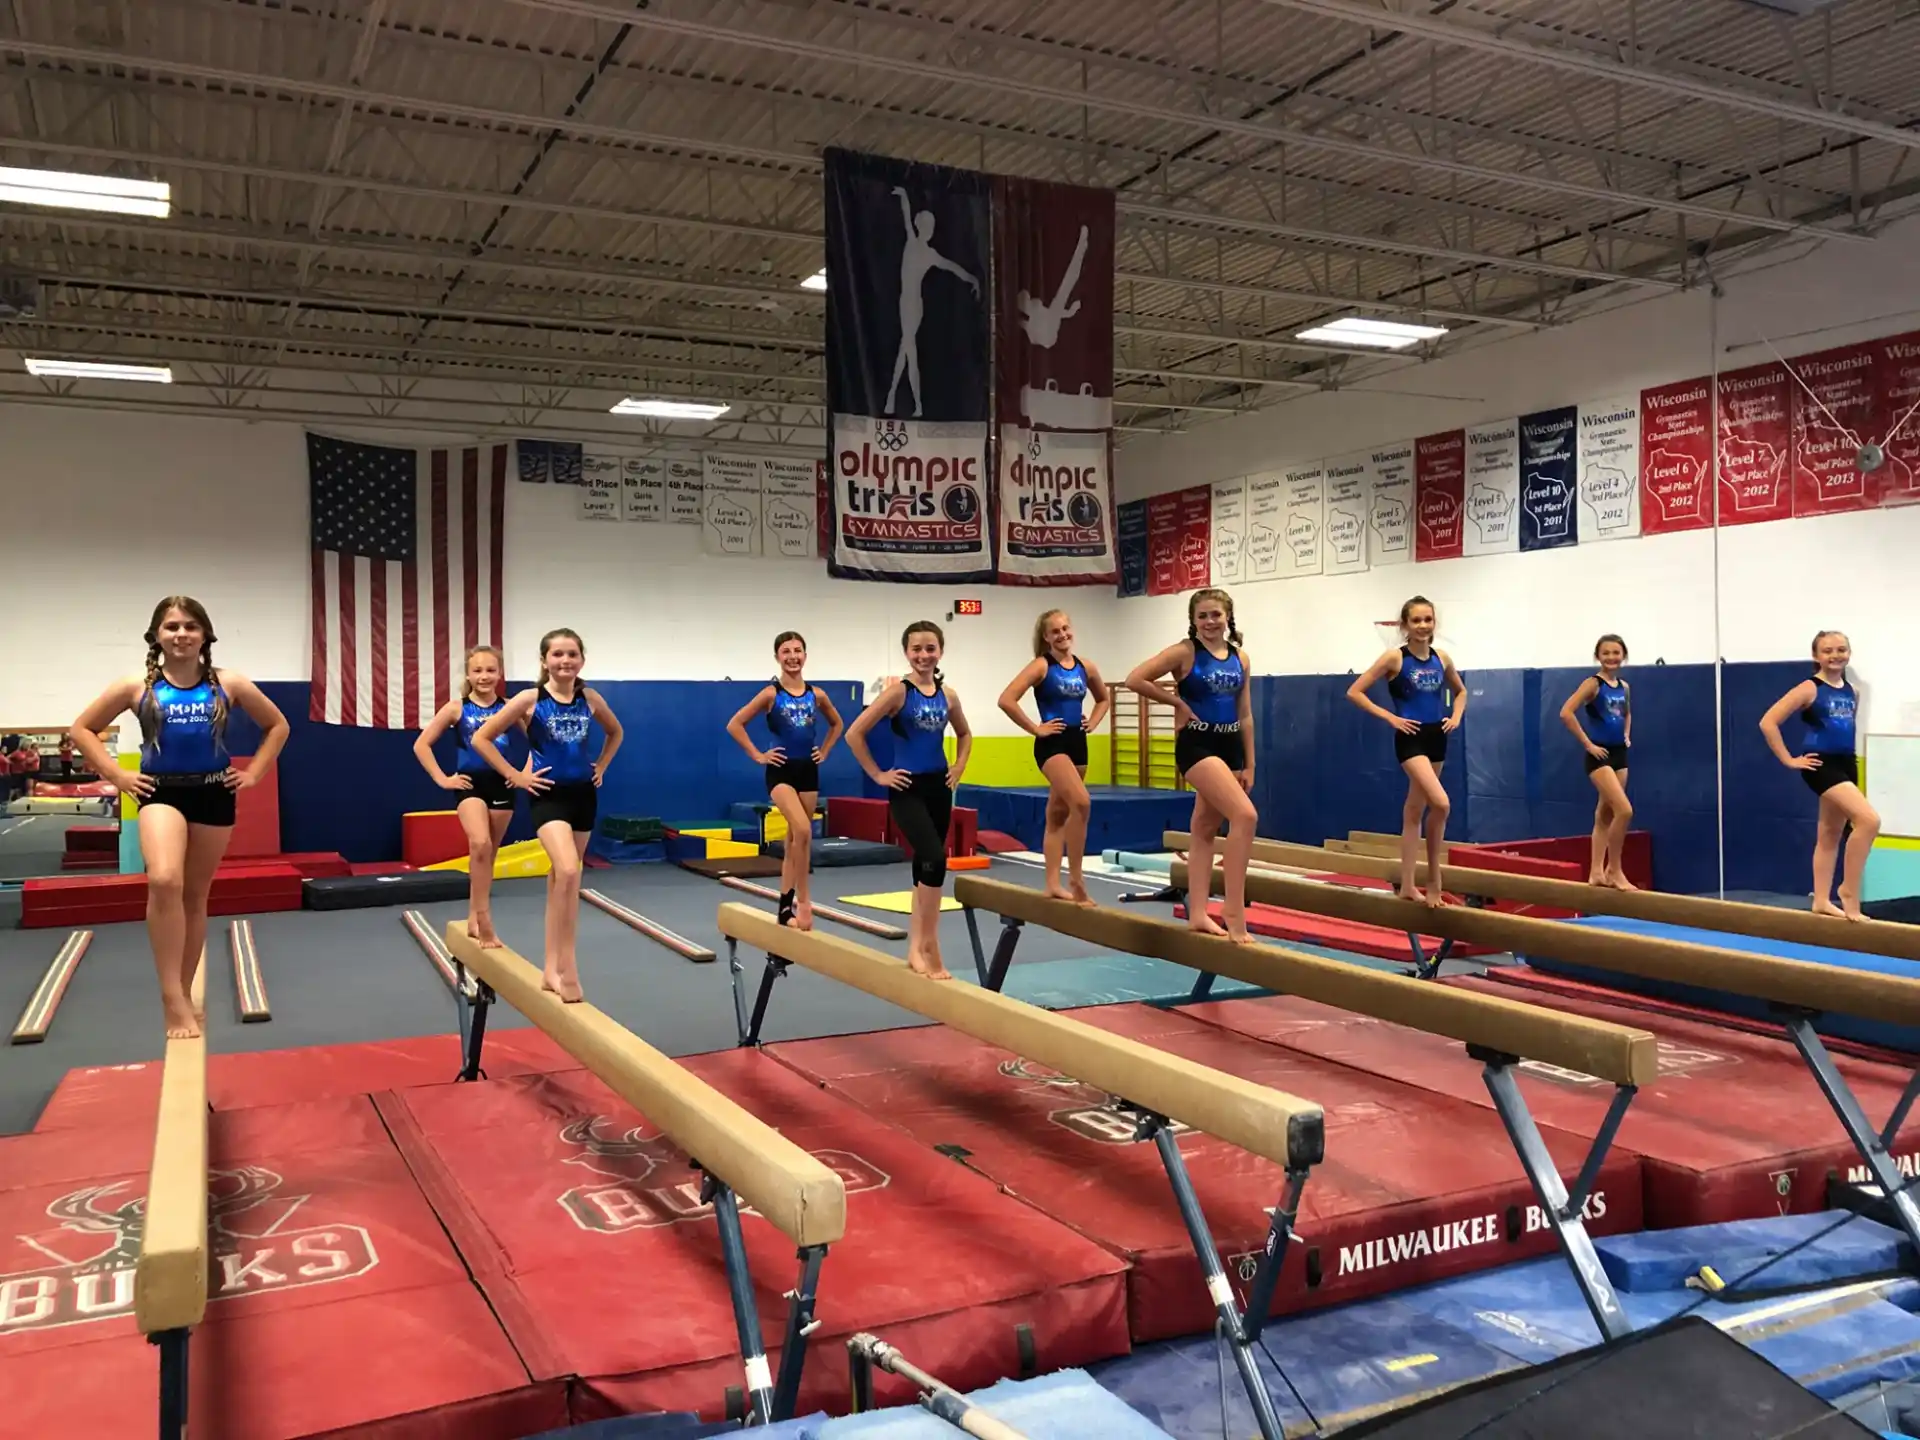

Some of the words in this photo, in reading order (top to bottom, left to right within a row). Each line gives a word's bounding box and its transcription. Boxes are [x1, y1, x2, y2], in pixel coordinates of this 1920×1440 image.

[1799, 351, 1873, 378] Wisconsin
[1718, 371, 1785, 394] Wisconsin
[1646, 386, 1708, 410] Wisconsin
[1581, 407, 1636, 428] Wisconsin
[1655, 409, 1698, 426] Gymnastics
[874, 420, 907, 432] USA
[1523, 417, 1573, 437] Wisconsin
[1667, 420, 1686, 431] State
[1469, 428, 1515, 445] Wisconsin
[1589, 427, 1627, 441] Gymnastics
[1647, 424, 1705, 442] Championships
[1419, 438, 1462, 454] Wisconsin
[1582, 443, 1633, 458] Championships
[1806, 436, 1837, 455] Level
[1371, 446, 1412, 463] Wisconsin
[1725, 449, 1754, 467] Level
[1757, 449, 1765, 462] 7
[707, 455, 757, 469] Wisconsin
[763, 460, 813, 474] Wisconsin
[839, 443, 978, 492] olympic
[1813, 460, 1829, 472] 2nd
[1831, 457, 1855, 470] Place
[1285, 467, 1321, 482] Wisconsin
[1327, 462, 1364, 478] Wisconsin
[1653, 463, 1680, 479] Level
[1682, 462, 1689, 474] 6
[1730, 471, 1746, 483] 2nd
[1747, 468, 1768, 481] Place
[595, 478, 619, 489] Place
[640, 478, 662, 488] Place
[1589, 478, 1612, 492] Level
[1614, 478, 1619, 488] 4
[1825, 472, 1855, 487] 2013
[1528, 485, 1550, 500] Level
[1552, 485, 1561, 497] 10
[1658, 483, 1672, 494] 2nd
[1673, 481, 1692, 492] Place
[1743, 484, 1770, 497] 2012
[847, 480, 936, 517] trils
[1474, 494, 1494, 507] Level
[1604, 490, 1624, 501] Place
[1669, 495, 1693, 507] 2012
[583, 502, 607, 511] Level
[629, 503, 651, 512] Level
[671, 506, 694, 514] Level
[717, 508, 737, 517] Level
[1424, 501, 1444, 513] Level
[1543, 502, 1562, 512] Place
[774, 512, 794, 520] Level
[1376, 509, 1394, 519] Level
[1486, 511, 1503, 520] Place
[1600, 509, 1623, 520] 2012
[727, 518, 747, 527] Place
[784, 521, 803, 530] Place
[848, 518, 979, 539] GYMNASTICS
[1330, 521, 1346, 532] Level
[1487, 523, 1505, 533] 2011
[1543, 516, 1563, 527] 2011
[1289, 526, 1304, 536] Level
[166, 716, 188, 725] Camp
[189, 715, 209, 723] 2020
[1187, 720, 1209, 732] RO
[1213, 722, 1239, 733] NIKE
[1337, 1213, 1500, 1276] MILWAUKEE
[1525, 1191, 1607, 1233] BKS
[0, 1232, 350, 1326] BUKS
